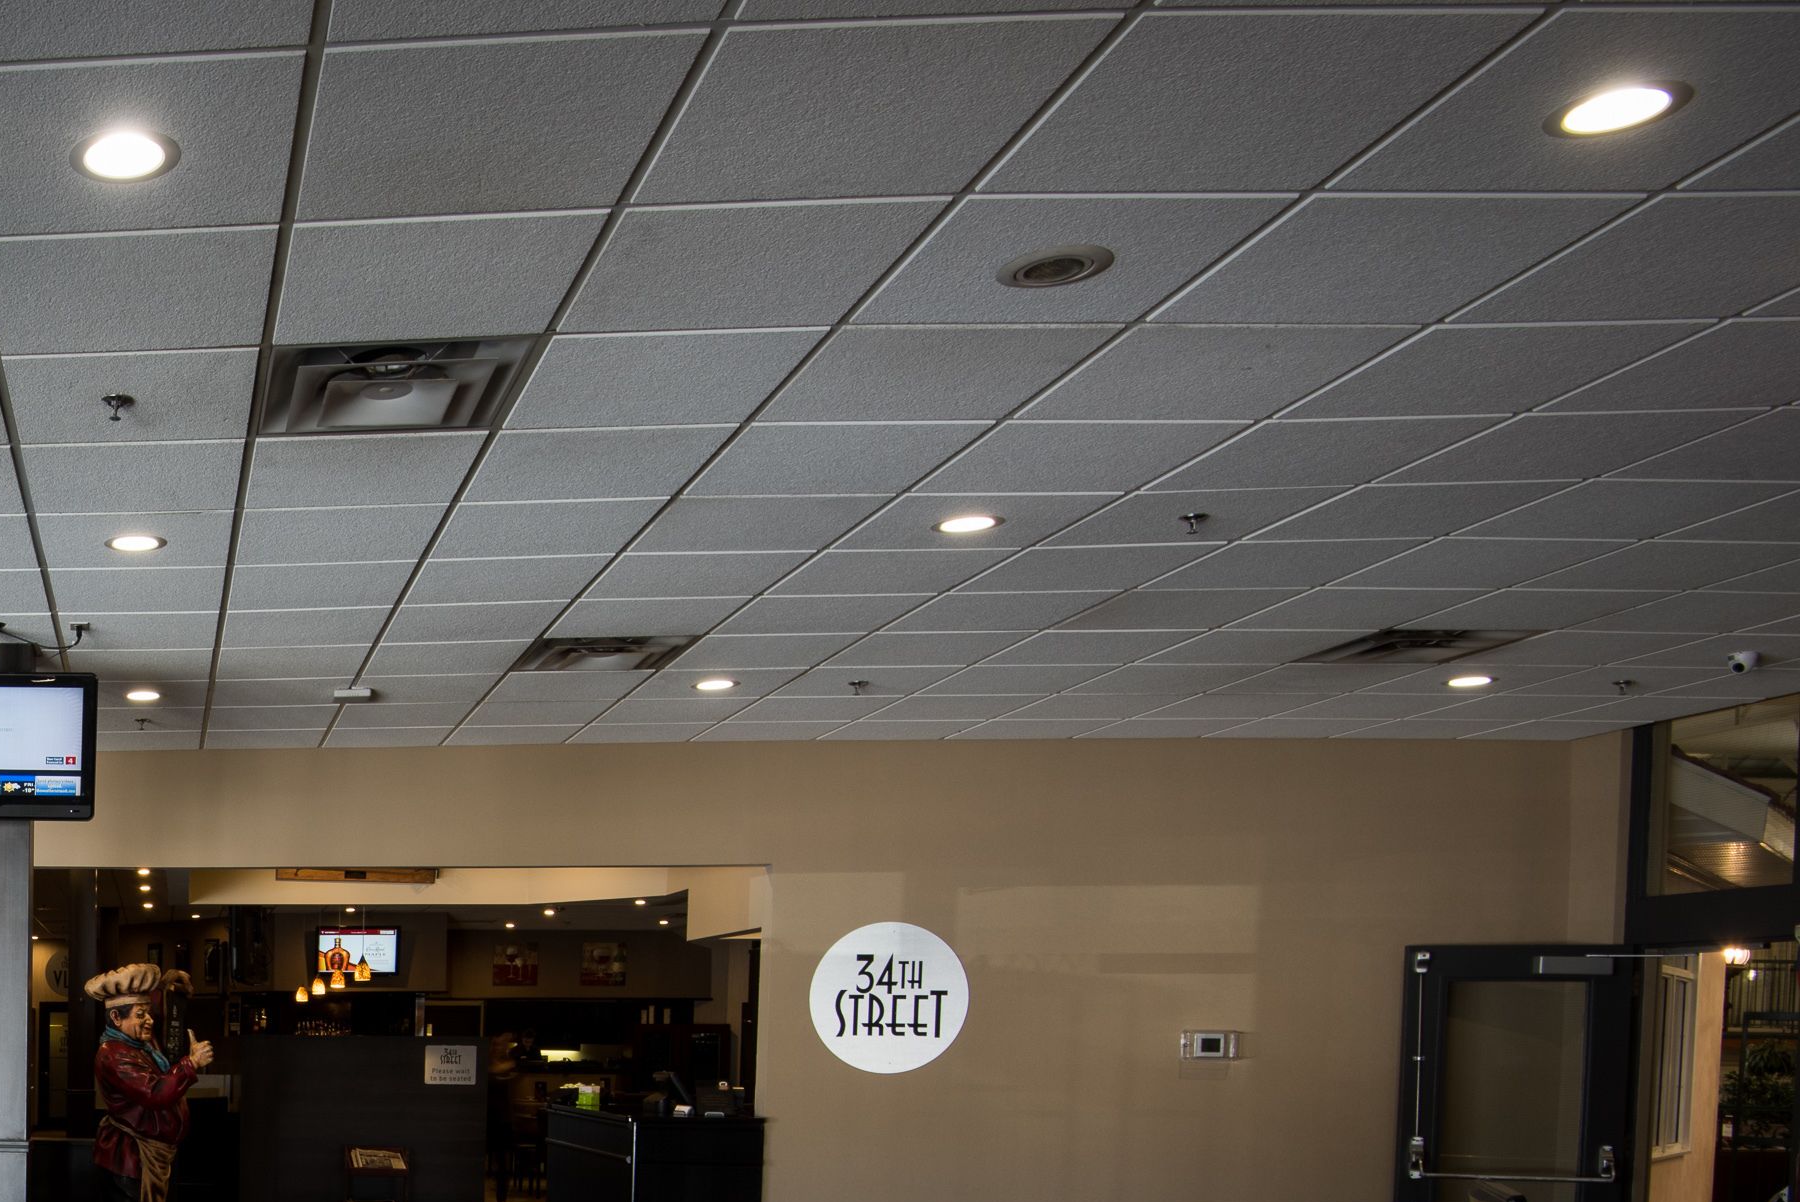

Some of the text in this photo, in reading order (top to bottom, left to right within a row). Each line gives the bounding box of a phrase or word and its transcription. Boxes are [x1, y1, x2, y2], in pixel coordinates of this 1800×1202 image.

[67, 757, 74, 765] 4
[856, 952, 924, 995] 34TH
[834, 989, 949, 1039] STREET
[440, 1054, 462, 1065] STREET
